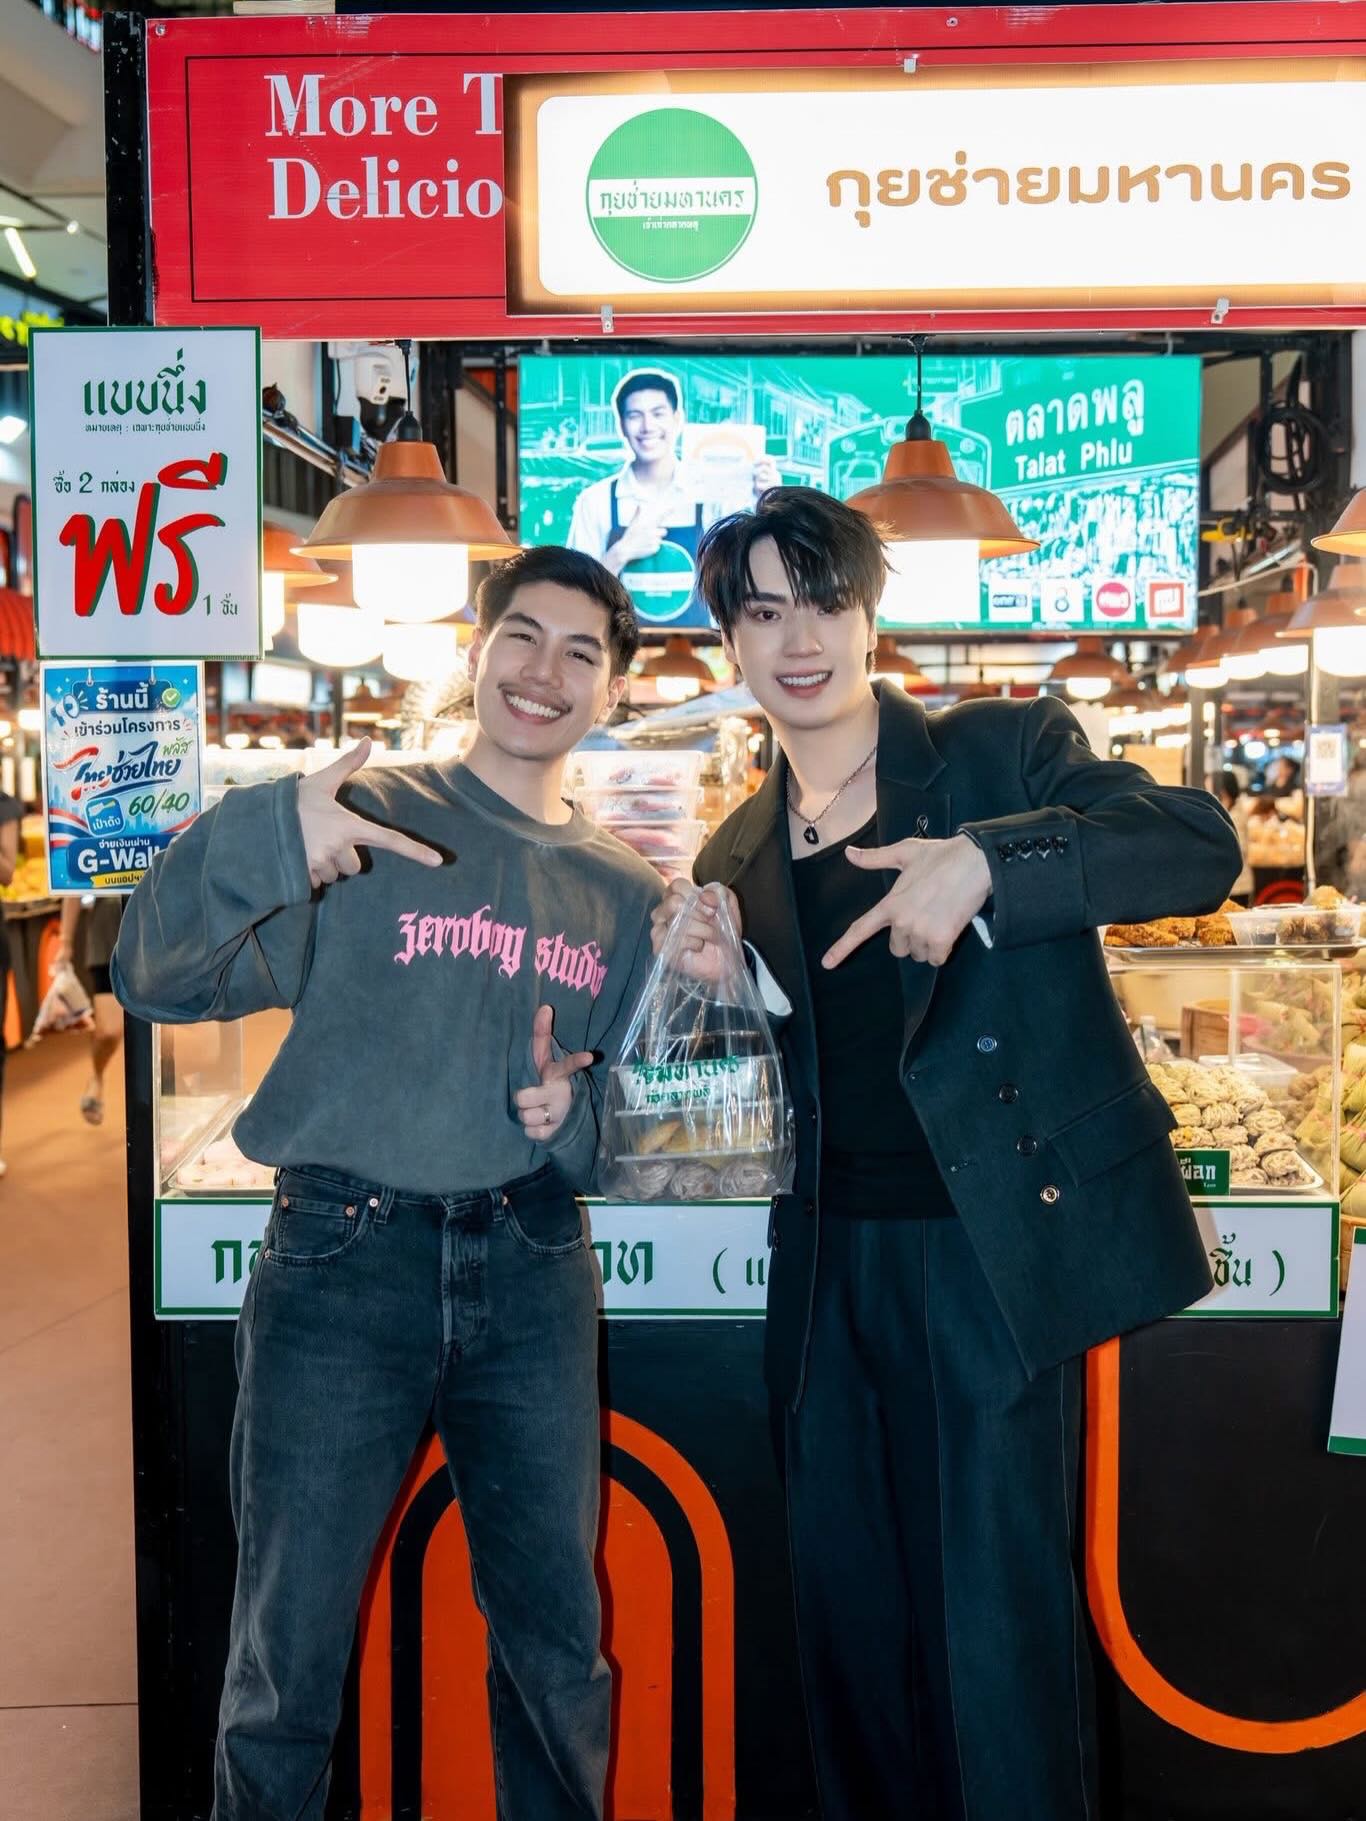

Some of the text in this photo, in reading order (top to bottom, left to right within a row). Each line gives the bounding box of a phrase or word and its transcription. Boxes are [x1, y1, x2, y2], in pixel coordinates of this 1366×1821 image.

[263, 73, 438, 137] More
[267, 157, 502, 221] Delicio
[600, 179, 745, 216] กุยช่ายมหานคร
[825, 150, 1351, 228] กุยช่ายมหานคร
[83, 347, 206, 416] แบบนึ่ง
[1005, 378, 1145, 446] ตลาดพลู
[79, 471, 93, 494] 2
[101, 469, 135, 494] กล่อง
[1015, 437, 1133, 482] Talat Phlu
[59, 452, 228, 617] ฟรี
[203, 592, 238, 616] 1 ชิ้น
[95, 681, 149, 711] ร้านนี้
[75, 717, 181, 738] เข้าร่วมโครงการ
[128, 788, 190, 819] 60/40
